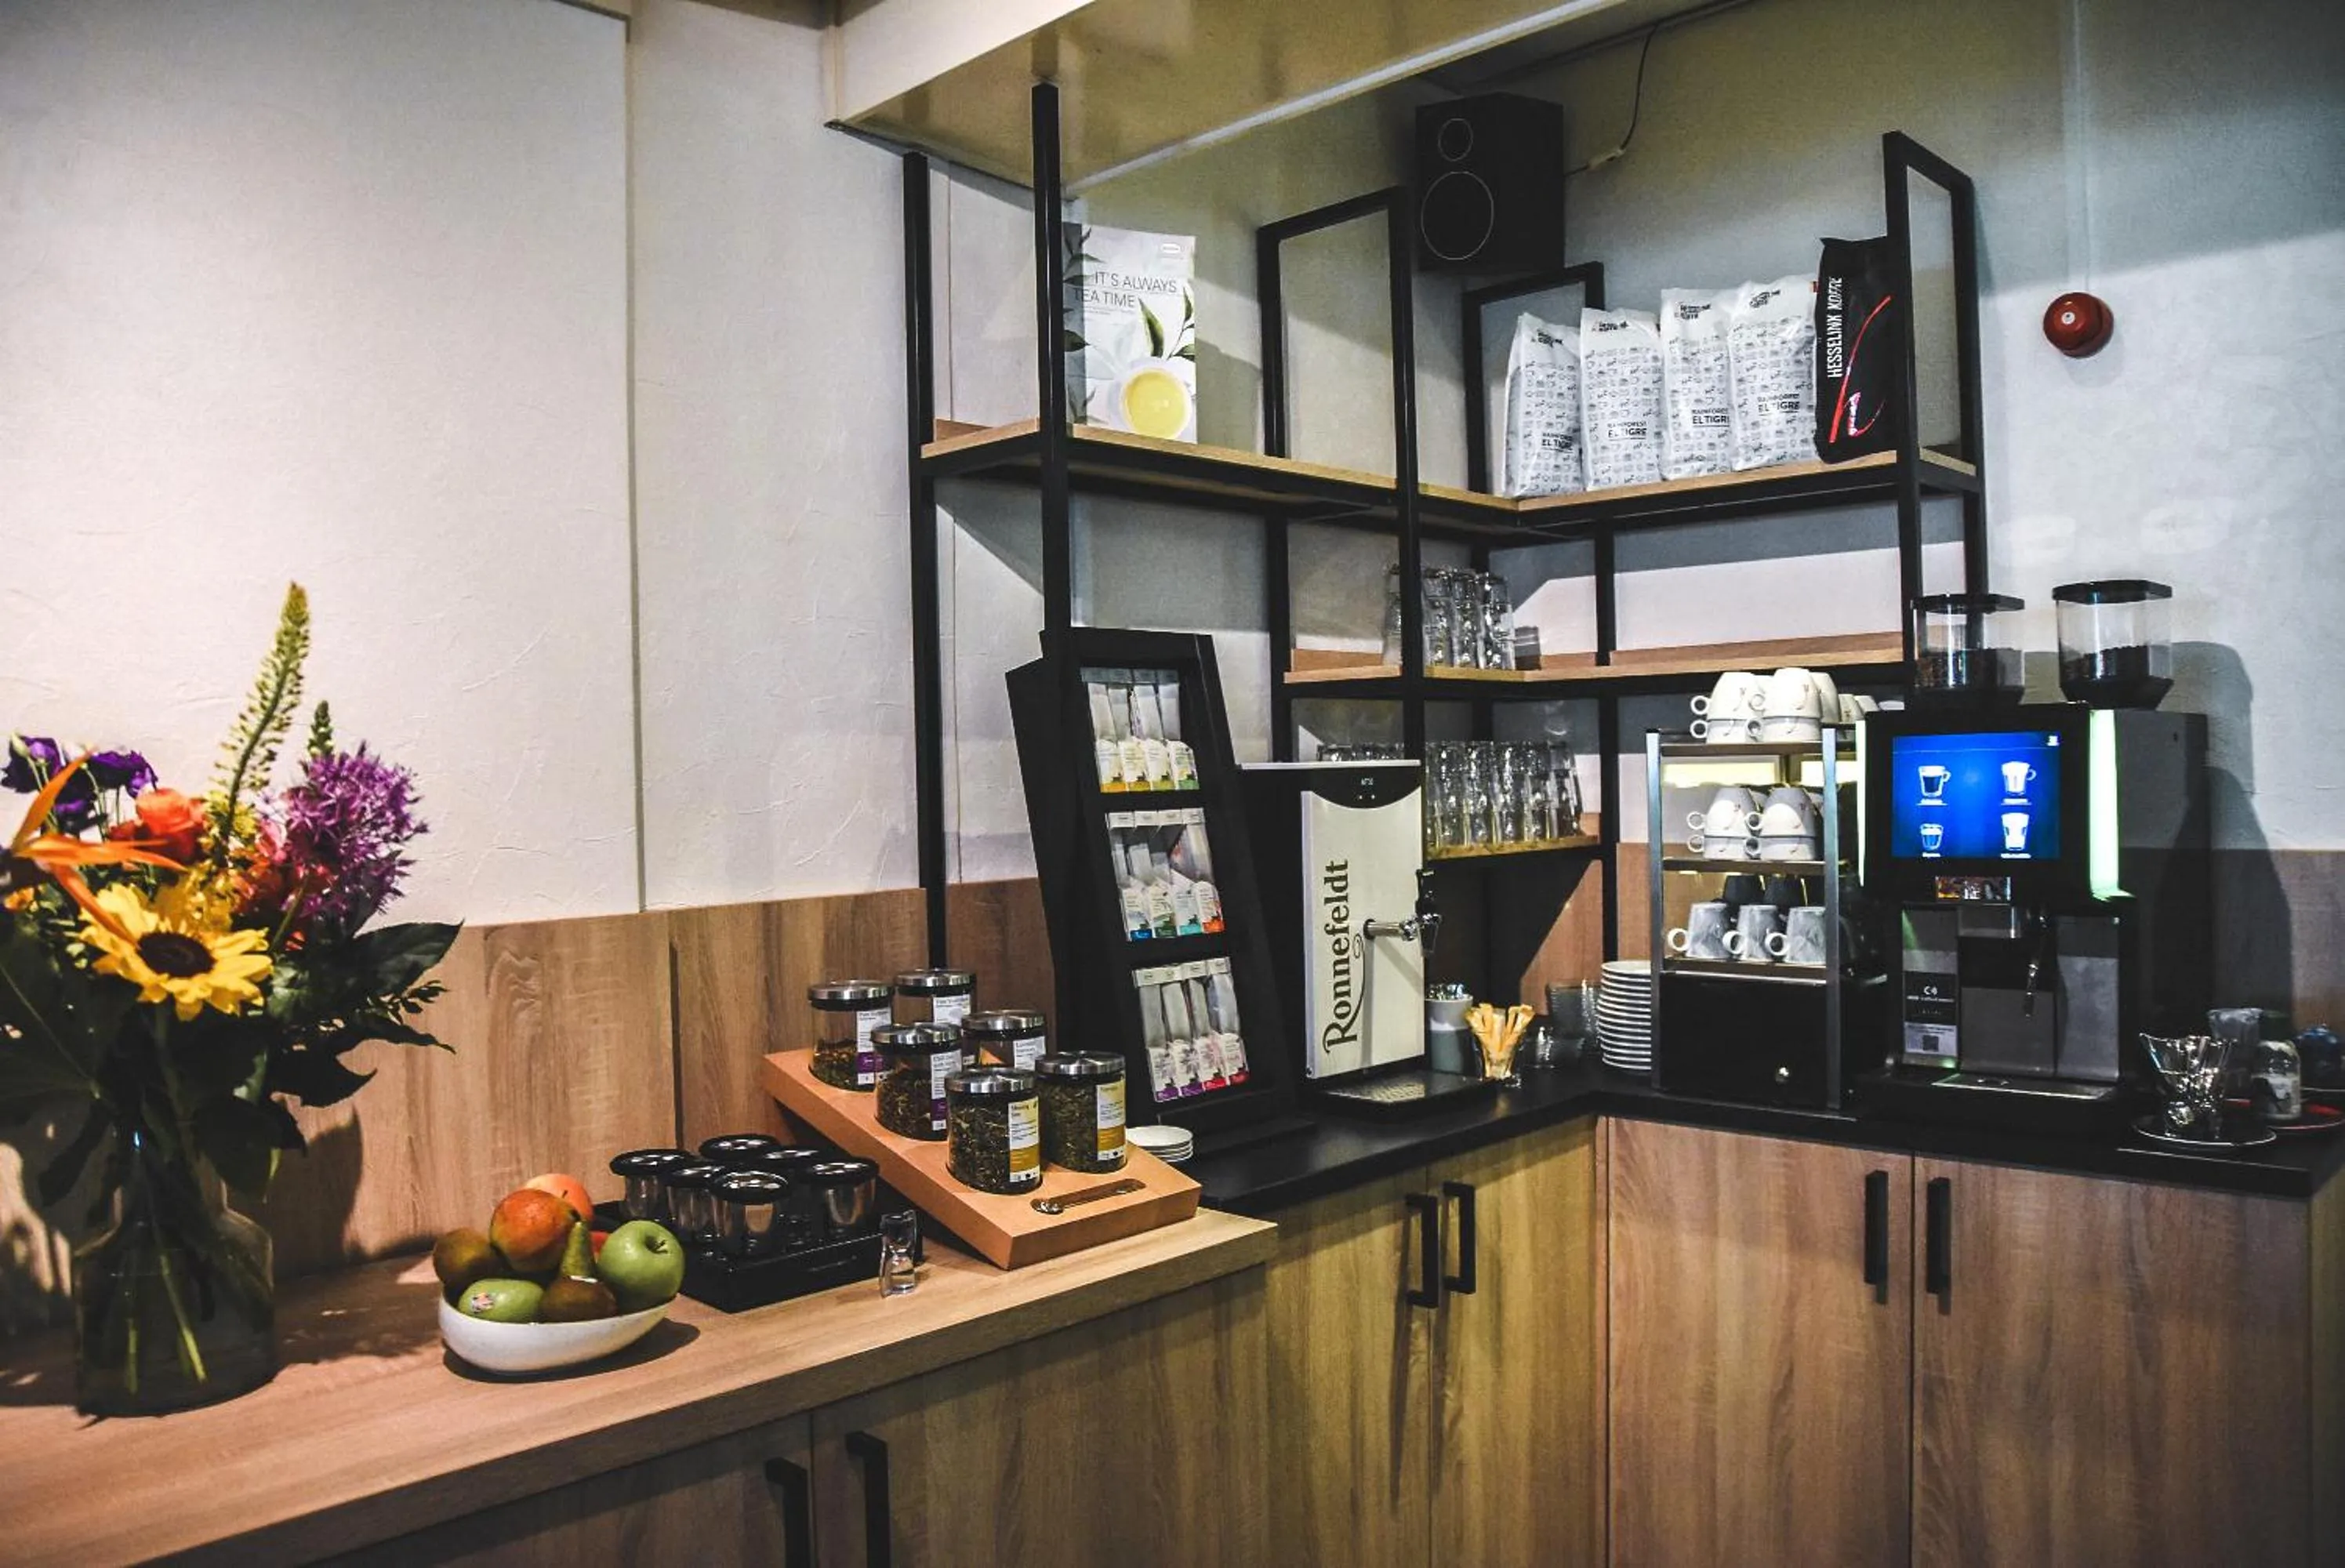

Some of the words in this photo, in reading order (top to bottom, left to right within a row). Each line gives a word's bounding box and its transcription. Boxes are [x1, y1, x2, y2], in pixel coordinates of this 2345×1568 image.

[1094, 270, 1119, 287] IT'S
[1123, 275, 1177, 293] ALWAYS
[1104, 291, 1134, 308] TIME
[1826, 314, 1842, 379] HESSELINK
[1693, 416, 1704, 424] EL
[1542, 438, 1552, 447] EL
[1323, 859, 1366, 1054] Ronnefeldt
